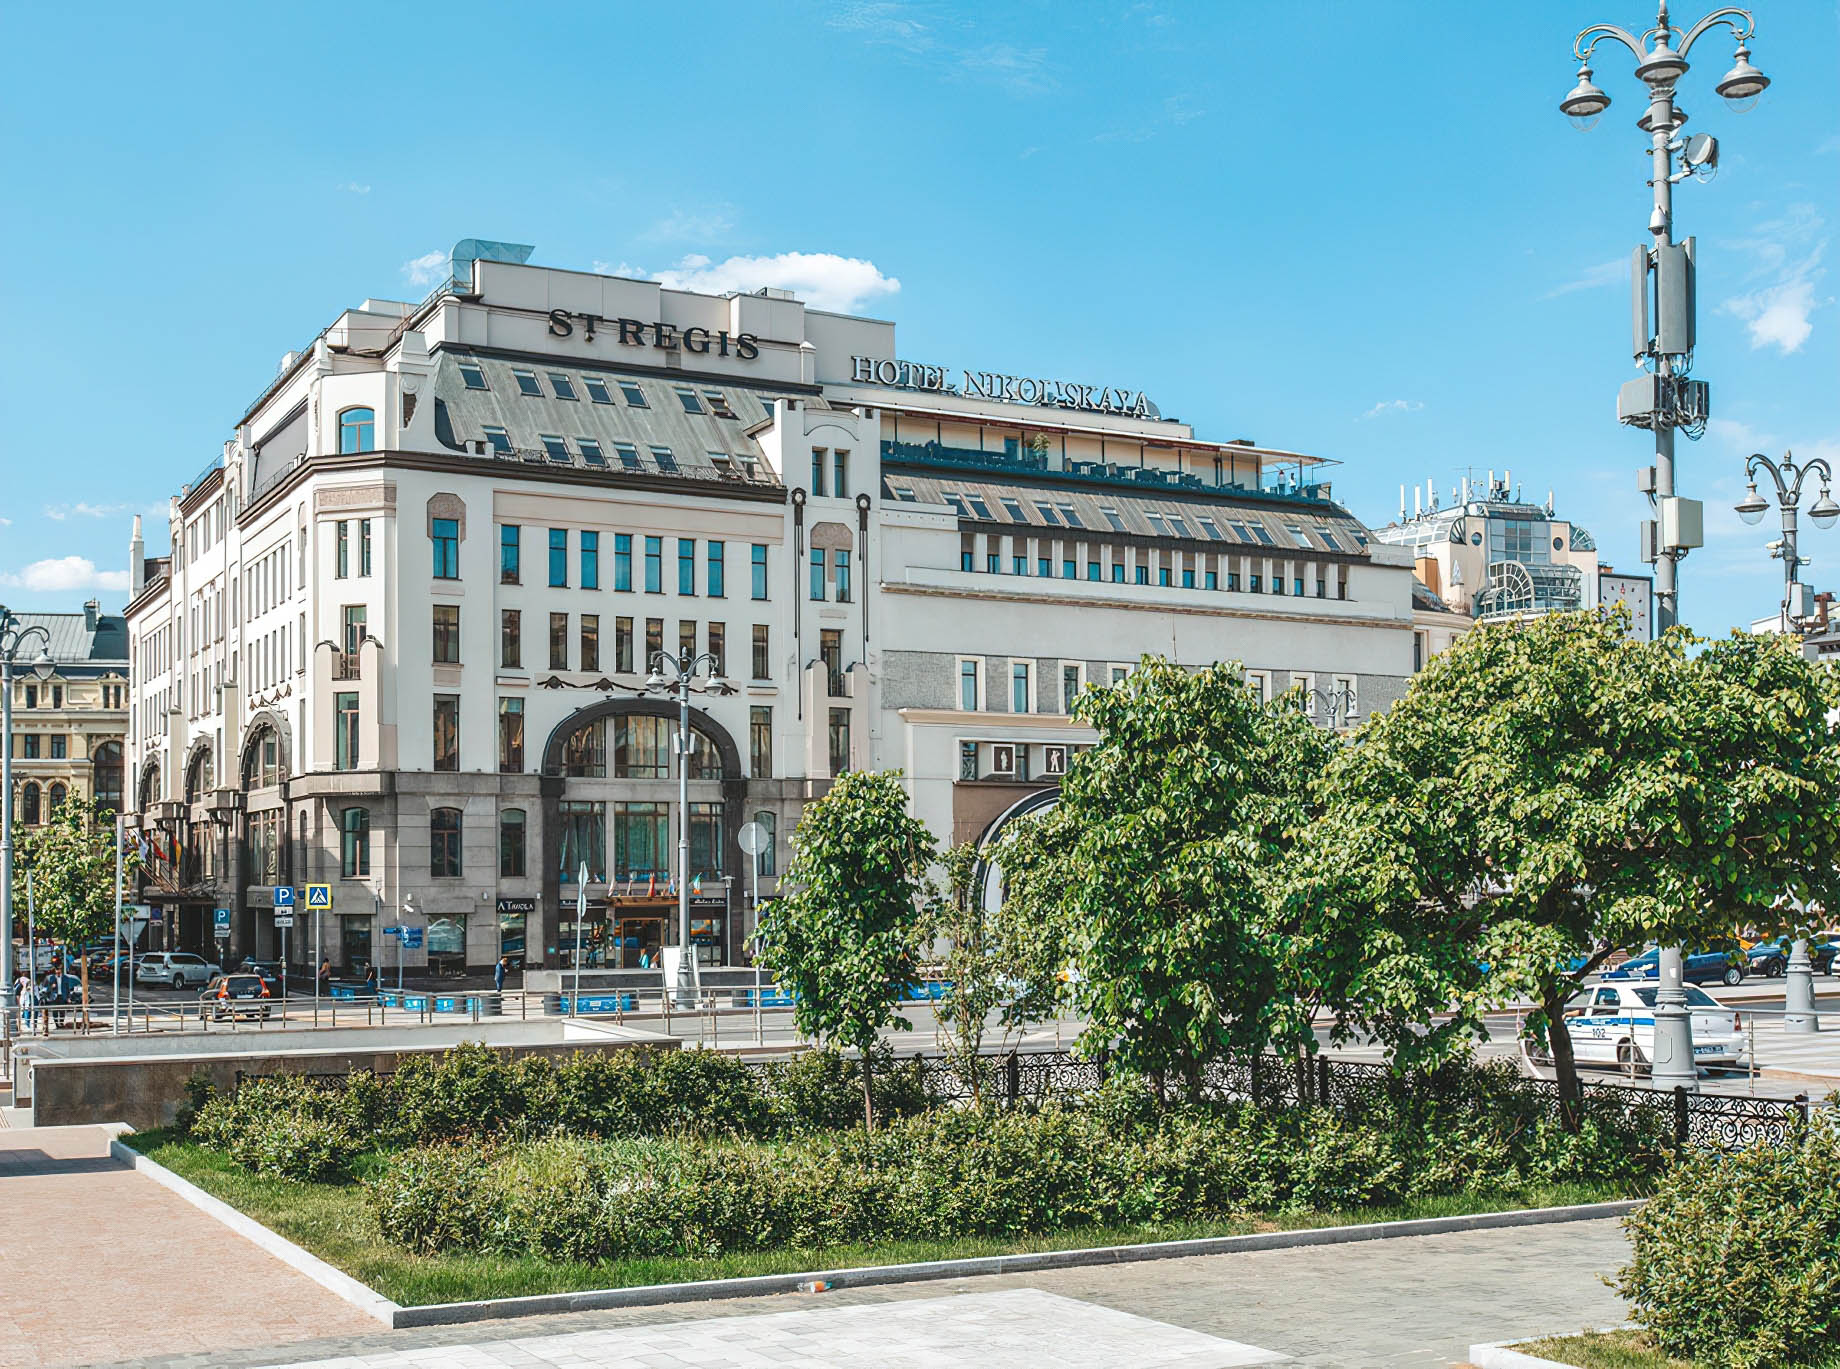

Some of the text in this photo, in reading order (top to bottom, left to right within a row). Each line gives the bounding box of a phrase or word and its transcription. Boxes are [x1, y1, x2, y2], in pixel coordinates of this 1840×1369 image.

[618, 318, 759, 360] REGIS
[851, 356, 956, 395] HOTEL
[279, 888, 290, 903] P
[218, 910, 226, 922] P
[1592, 1027, 1606, 1039] 102
